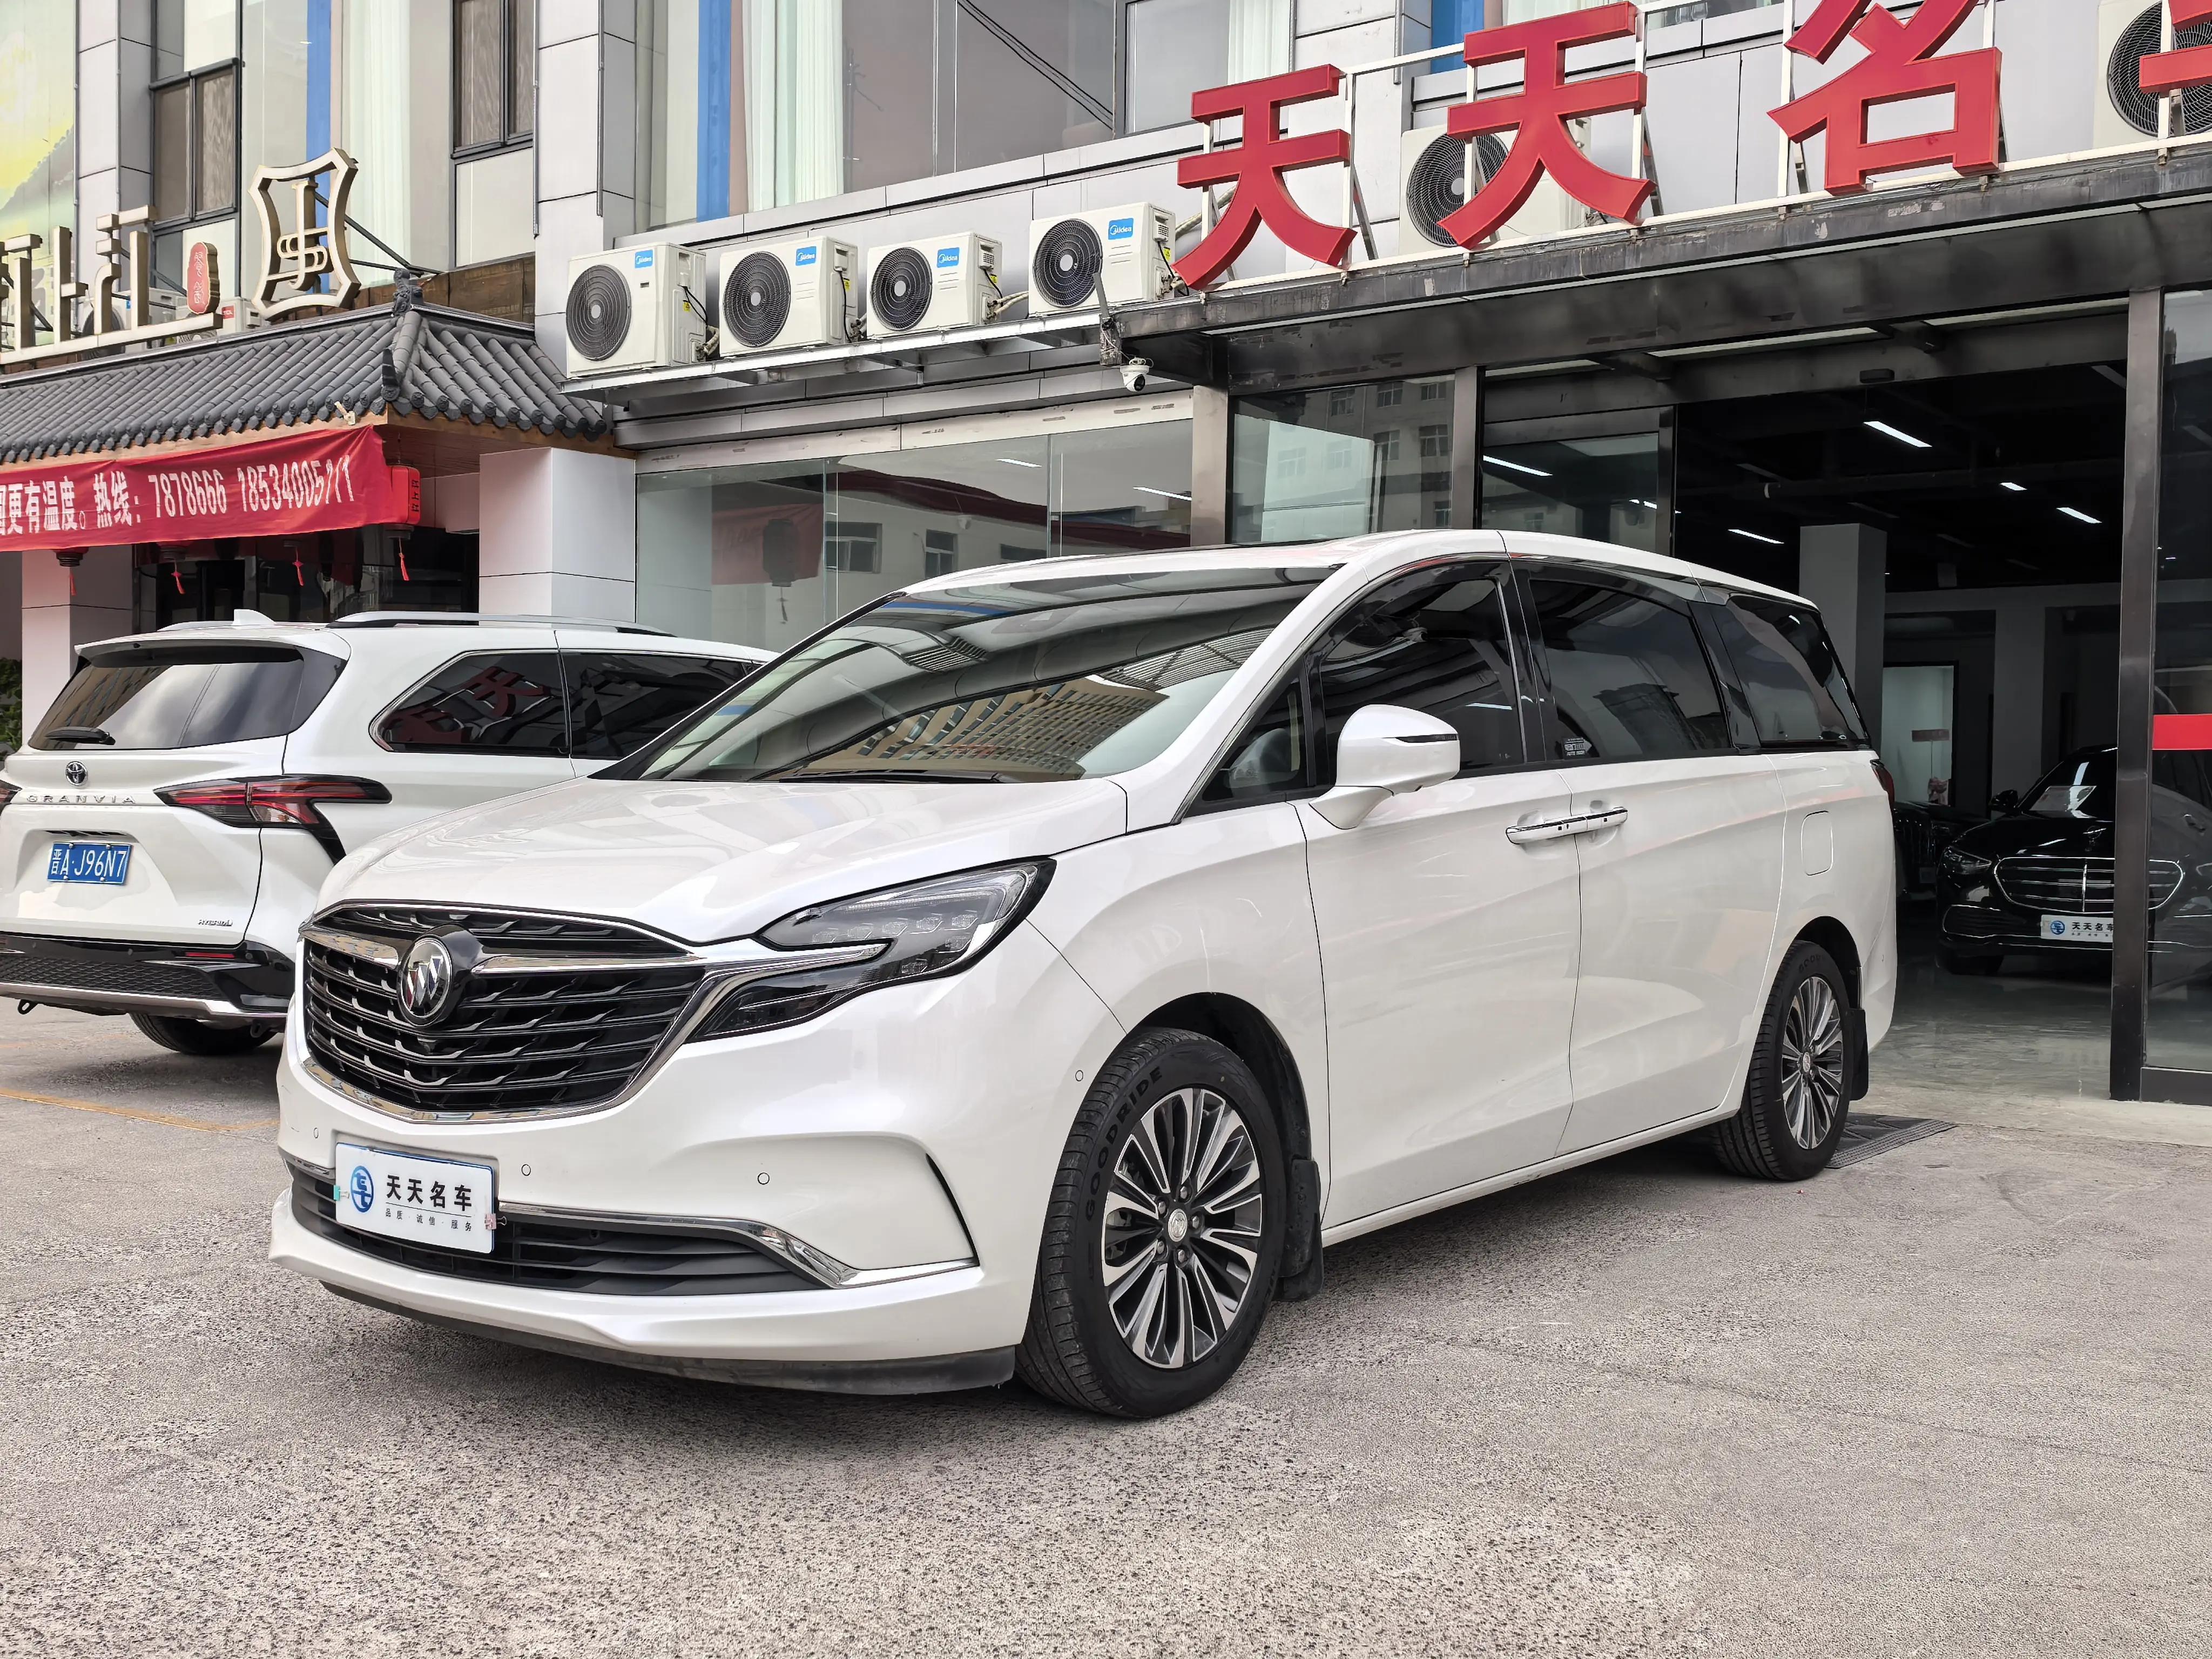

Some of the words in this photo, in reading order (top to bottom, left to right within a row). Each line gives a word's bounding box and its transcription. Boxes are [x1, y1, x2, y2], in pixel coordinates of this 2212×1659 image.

[1171, 0, 2212, 291] 天天名
[148, 469, 227, 518] 7878666
[27, 795, 136, 804] GRANVIA
[1085, 1066, 1163, 1222] GOODRIDE
[387, 1174, 473, 1211] 天天名车
